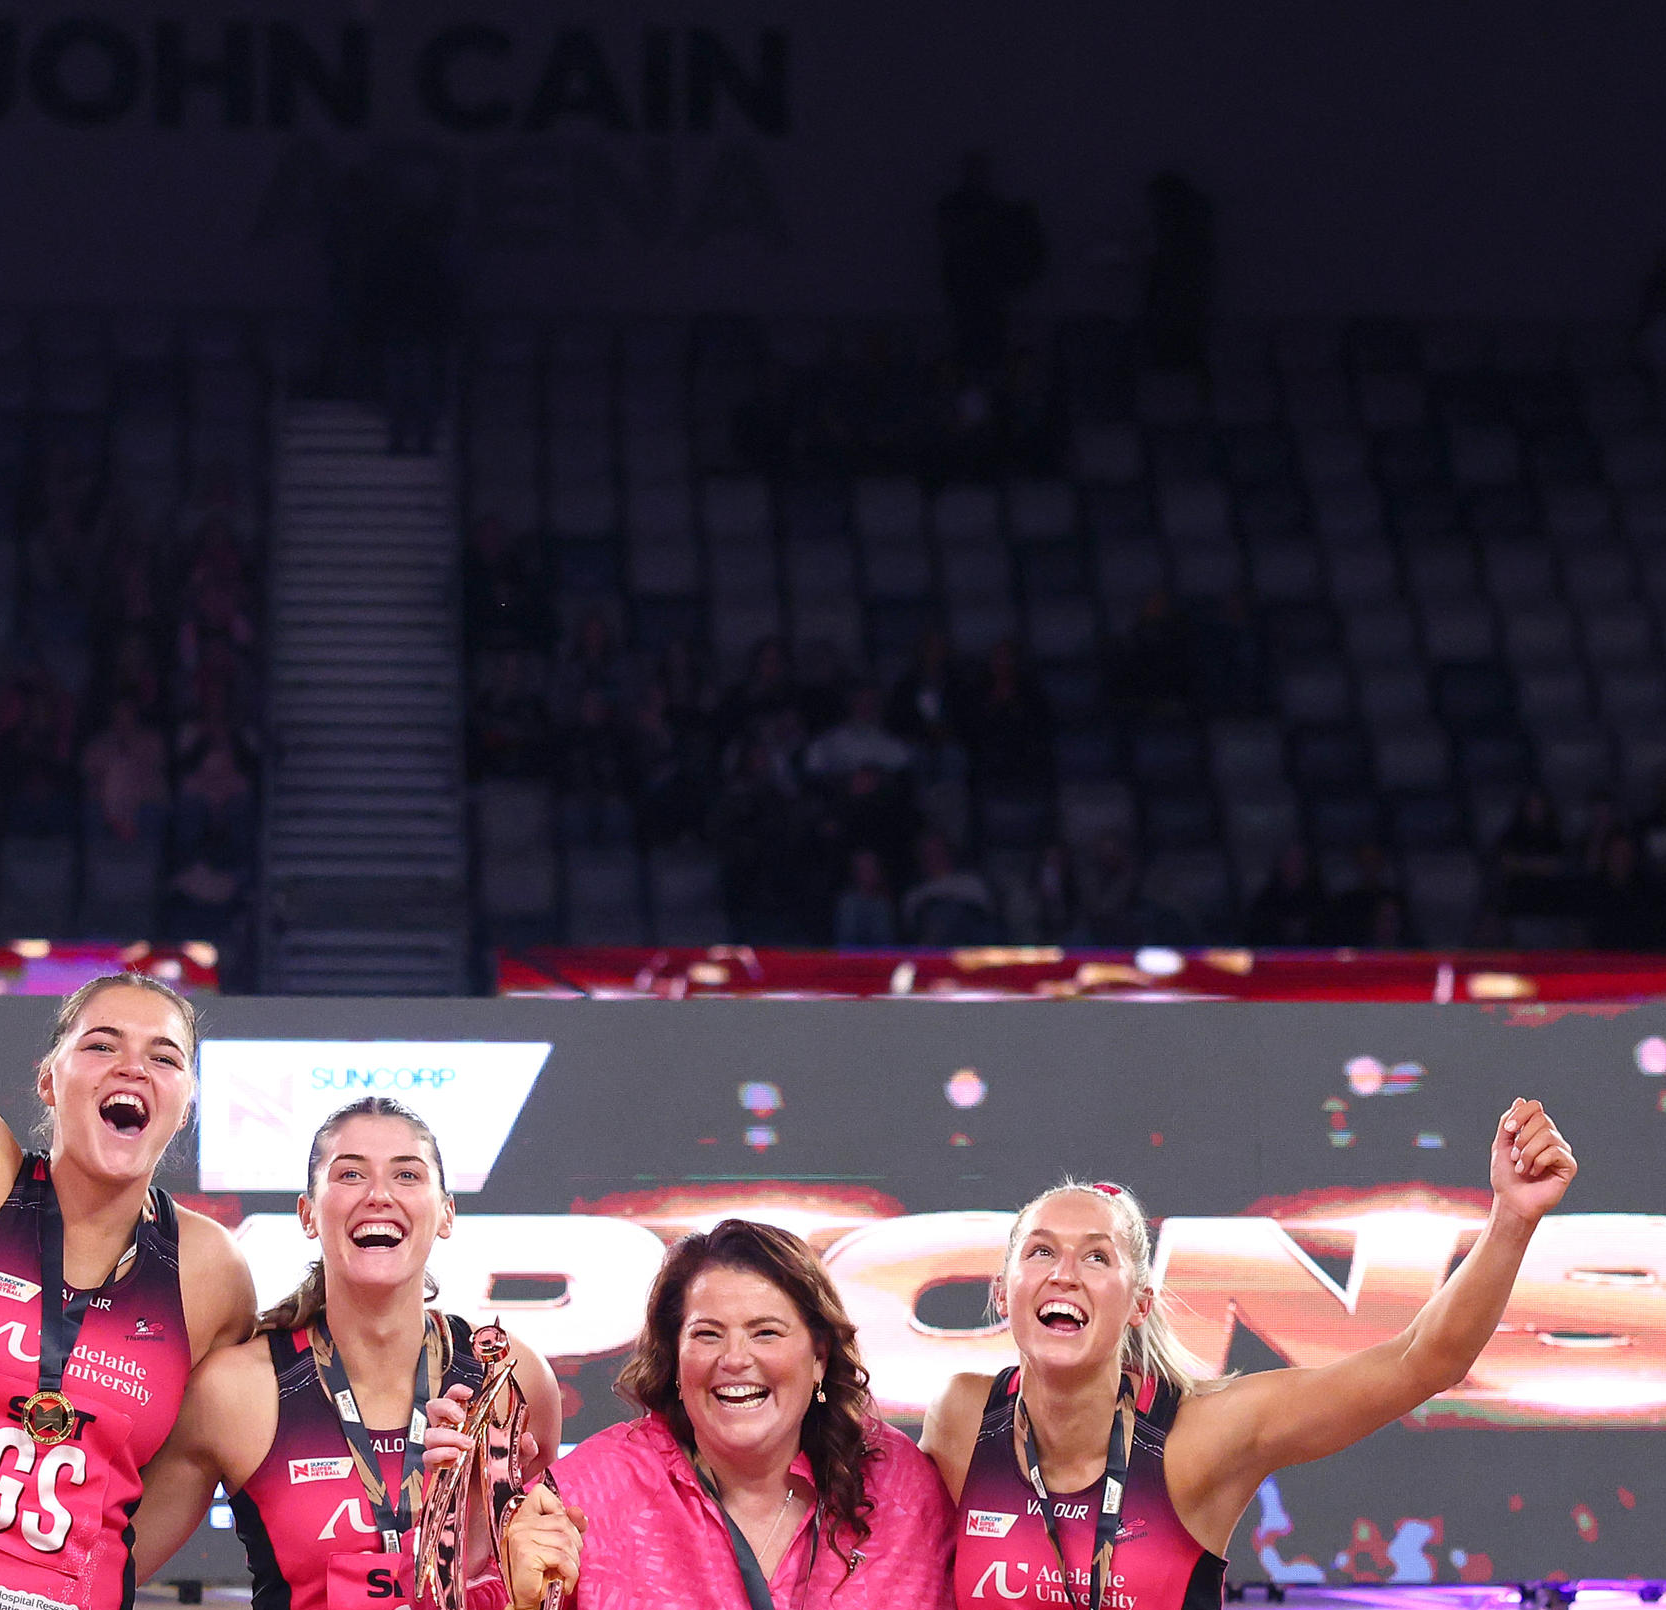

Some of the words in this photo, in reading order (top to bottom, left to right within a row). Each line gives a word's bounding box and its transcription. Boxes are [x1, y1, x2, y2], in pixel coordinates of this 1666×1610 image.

[414, 24, 793, 137] CAIN
[312, 1068, 456, 1089] SUNCORP
[70, 1345, 147, 1380] delaide
[66, 1362, 153, 1405] niversity
